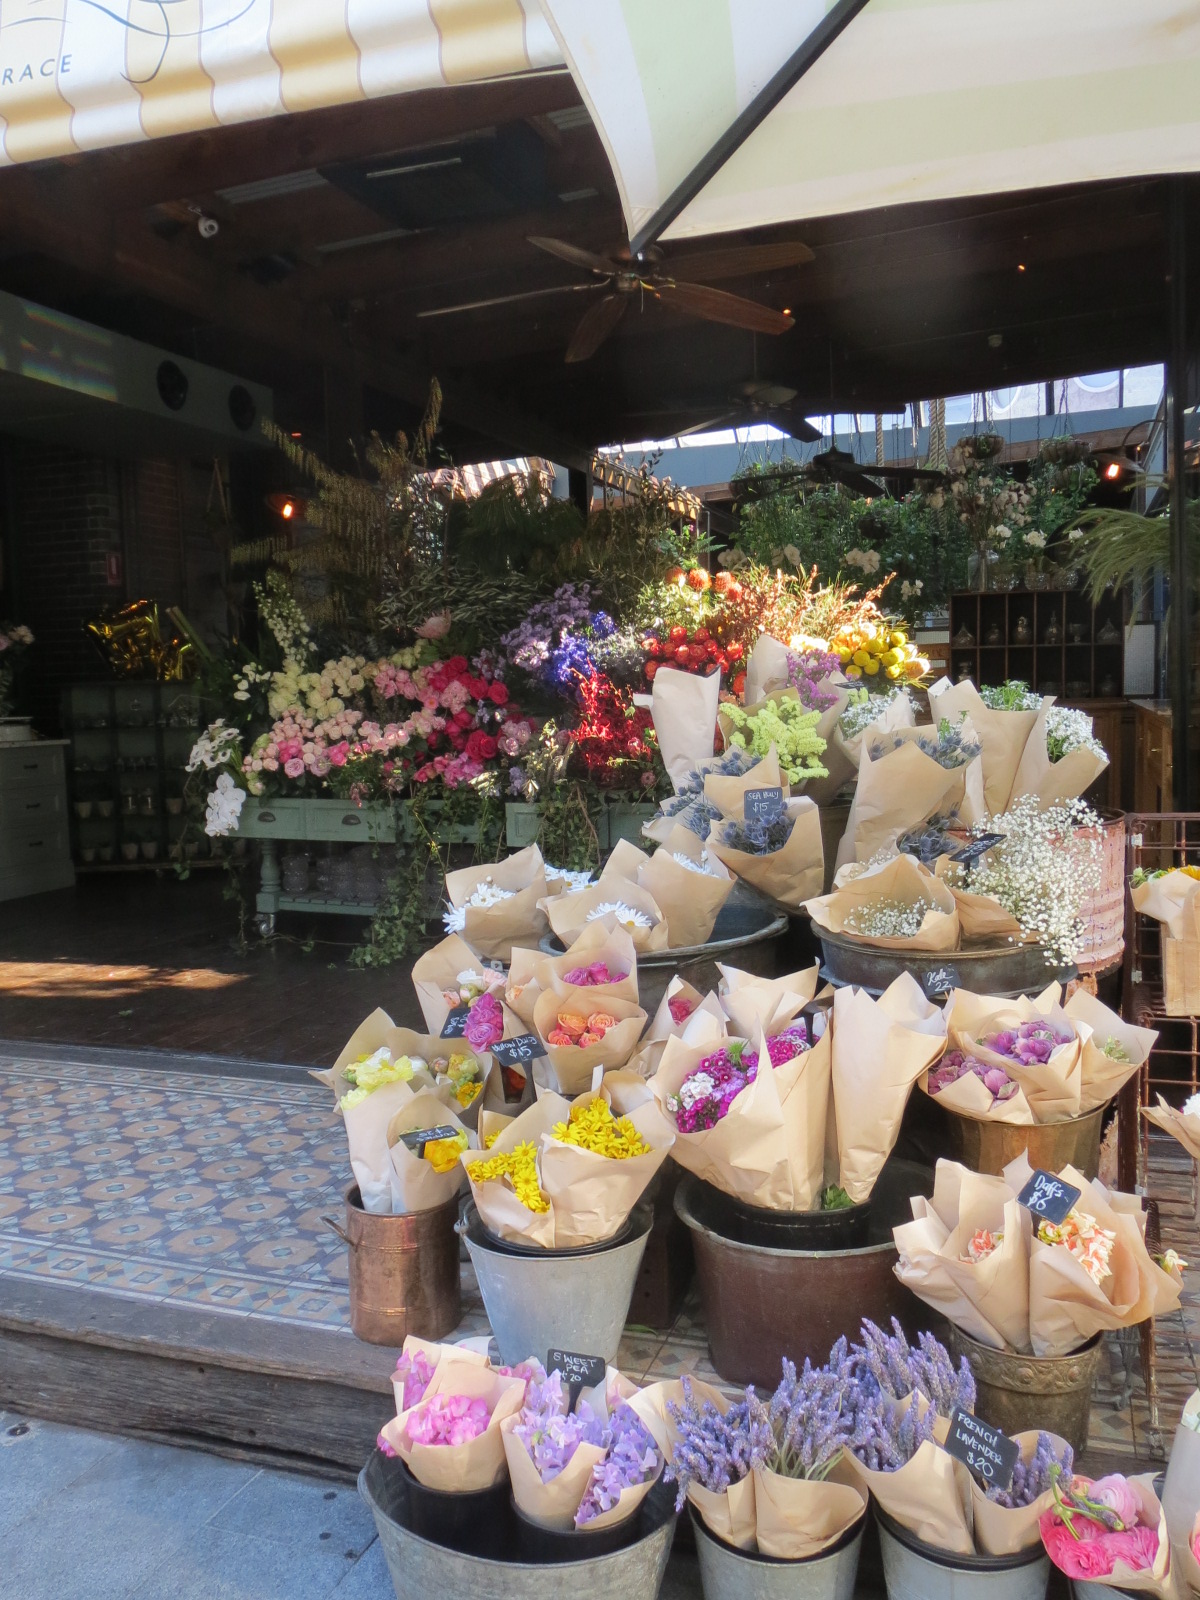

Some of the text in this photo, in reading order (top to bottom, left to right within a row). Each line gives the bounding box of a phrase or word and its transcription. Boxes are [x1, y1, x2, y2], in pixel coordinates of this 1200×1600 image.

[2, 54, 72, 85] RACE
[752, 802, 770, 813] $15
[508, 1045, 532, 1058] $15
[1034, 1174, 1065, 1198] Daffs
[553, 1352, 597, 1368] SWEET
[565, 1363, 589, 1375] PEA
[957, 1412, 998, 1448] FRENCH
[956, 1428, 1003, 1466] LAVENDER
[966, 1451, 994, 1477] $20
